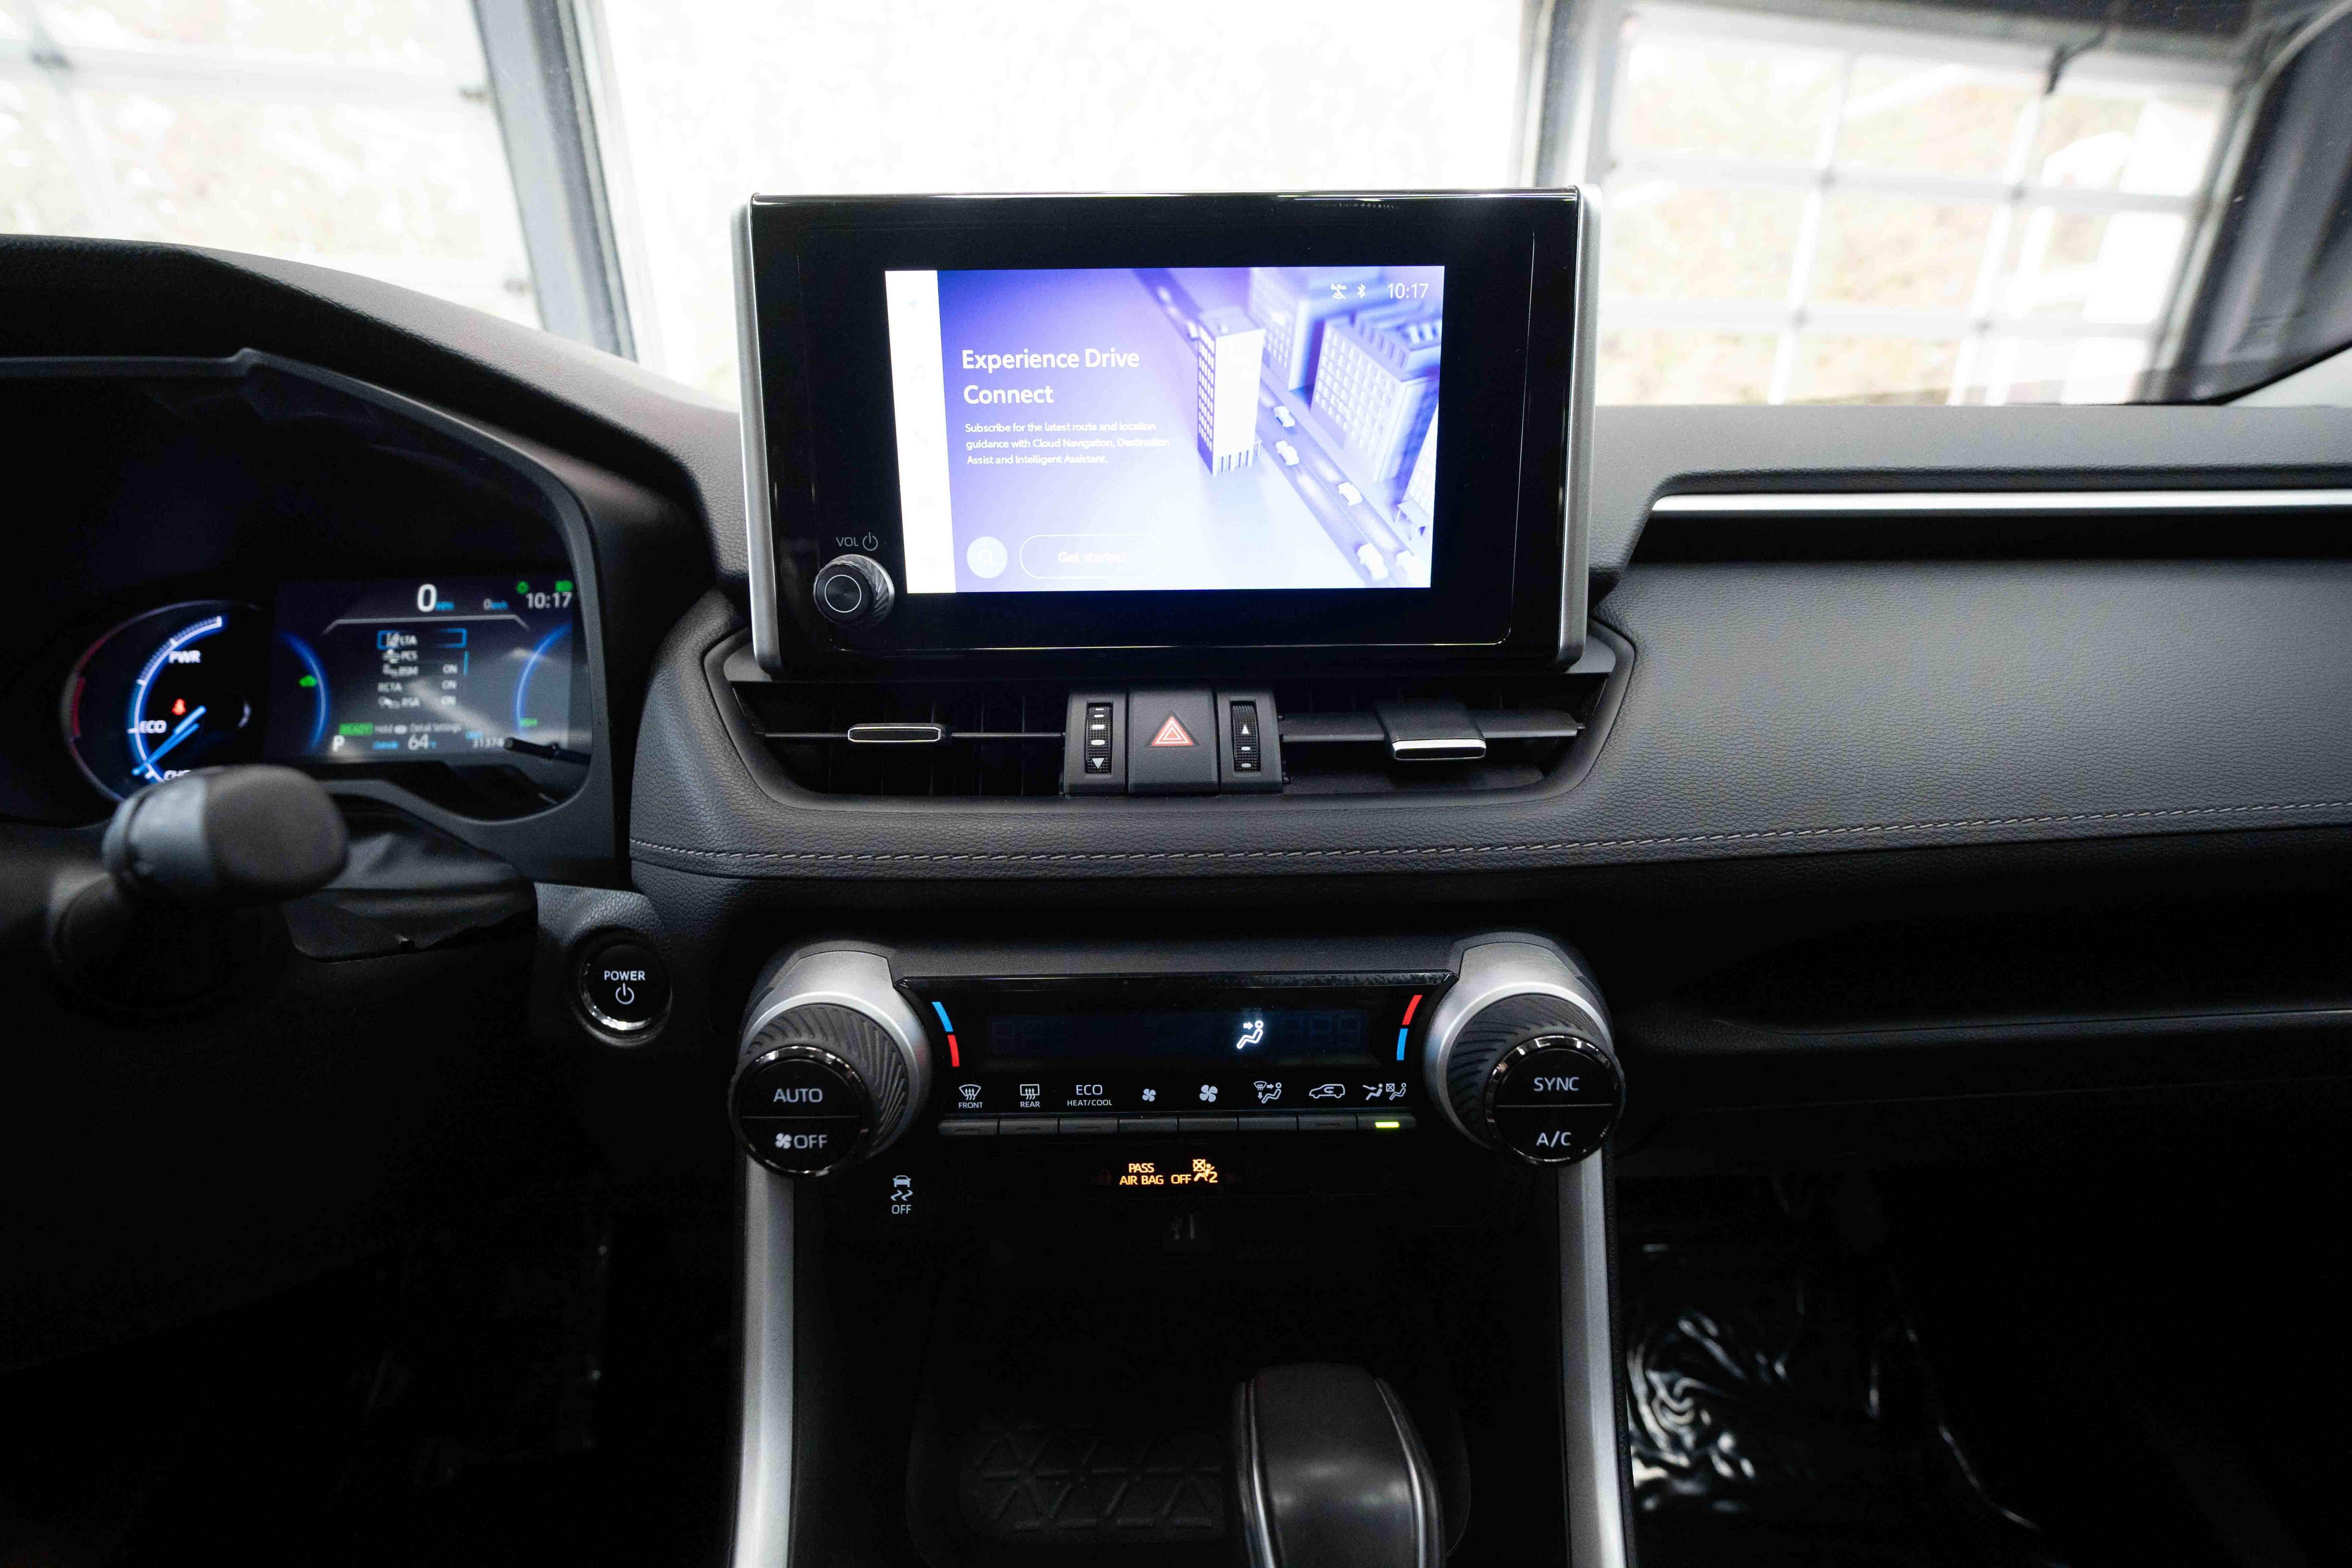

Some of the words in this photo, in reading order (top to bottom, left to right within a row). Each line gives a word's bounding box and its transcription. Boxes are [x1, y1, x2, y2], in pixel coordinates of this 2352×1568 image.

[1388, 283, 1430, 299] 10:17
[962, 349, 1079, 374] Experience
[1085, 347, 1140, 368] Drive
[963, 384, 1054, 405] Connect
[965, 423, 1011, 433] Subscribe
[1013, 423, 1026, 432] for
[1027, 423, 1042, 432] the
[1045, 422, 1071, 432] latest
[1073, 423, 1097, 431] route
[1099, 422, 1117, 431] and
[1119, 422, 1156, 431] location
[966, 439, 1009, 450] guidance
[1011, 439, 1031, 448] with
[1033, 439, 1060, 448] Cloud
[1063, 438, 1115, 449] Navigation,
[1117, 438, 1169, 447] Destination
[967, 456, 994, 464] Assist
[995, 455, 1013, 464] and
[1015, 455, 1062, 466] Intelligent
[1064, 454, 1109, 464] Assistant.
[836, 537, 859, 547] VOL
[1058, 552, 1079, 563] Get
[1084, 552, 1126, 563] started
[417, 584, 437, 612] 0
[526, 592, 572, 609] 10:17
[333, 735, 345, 752] P
[408, 734, 429, 751] 64
[604, 970, 645, 981] POWER
[1076, 1085, 1102, 1096] ECO
[1534, 1077, 1579, 1091] SYNC
[773, 1088, 823, 1102] AUTO
[794, 1134, 828, 1149] OFF
[1536, 1130, 1572, 1148] A/C
[1128, 1163, 1155, 1173] PASS
[1119, 1175, 1138, 1185] AIR
[1141, 1175, 1164, 1185] BAG
[1170, 1174, 1192, 1184] OFF
[892, 1205, 911, 1214] OFF
